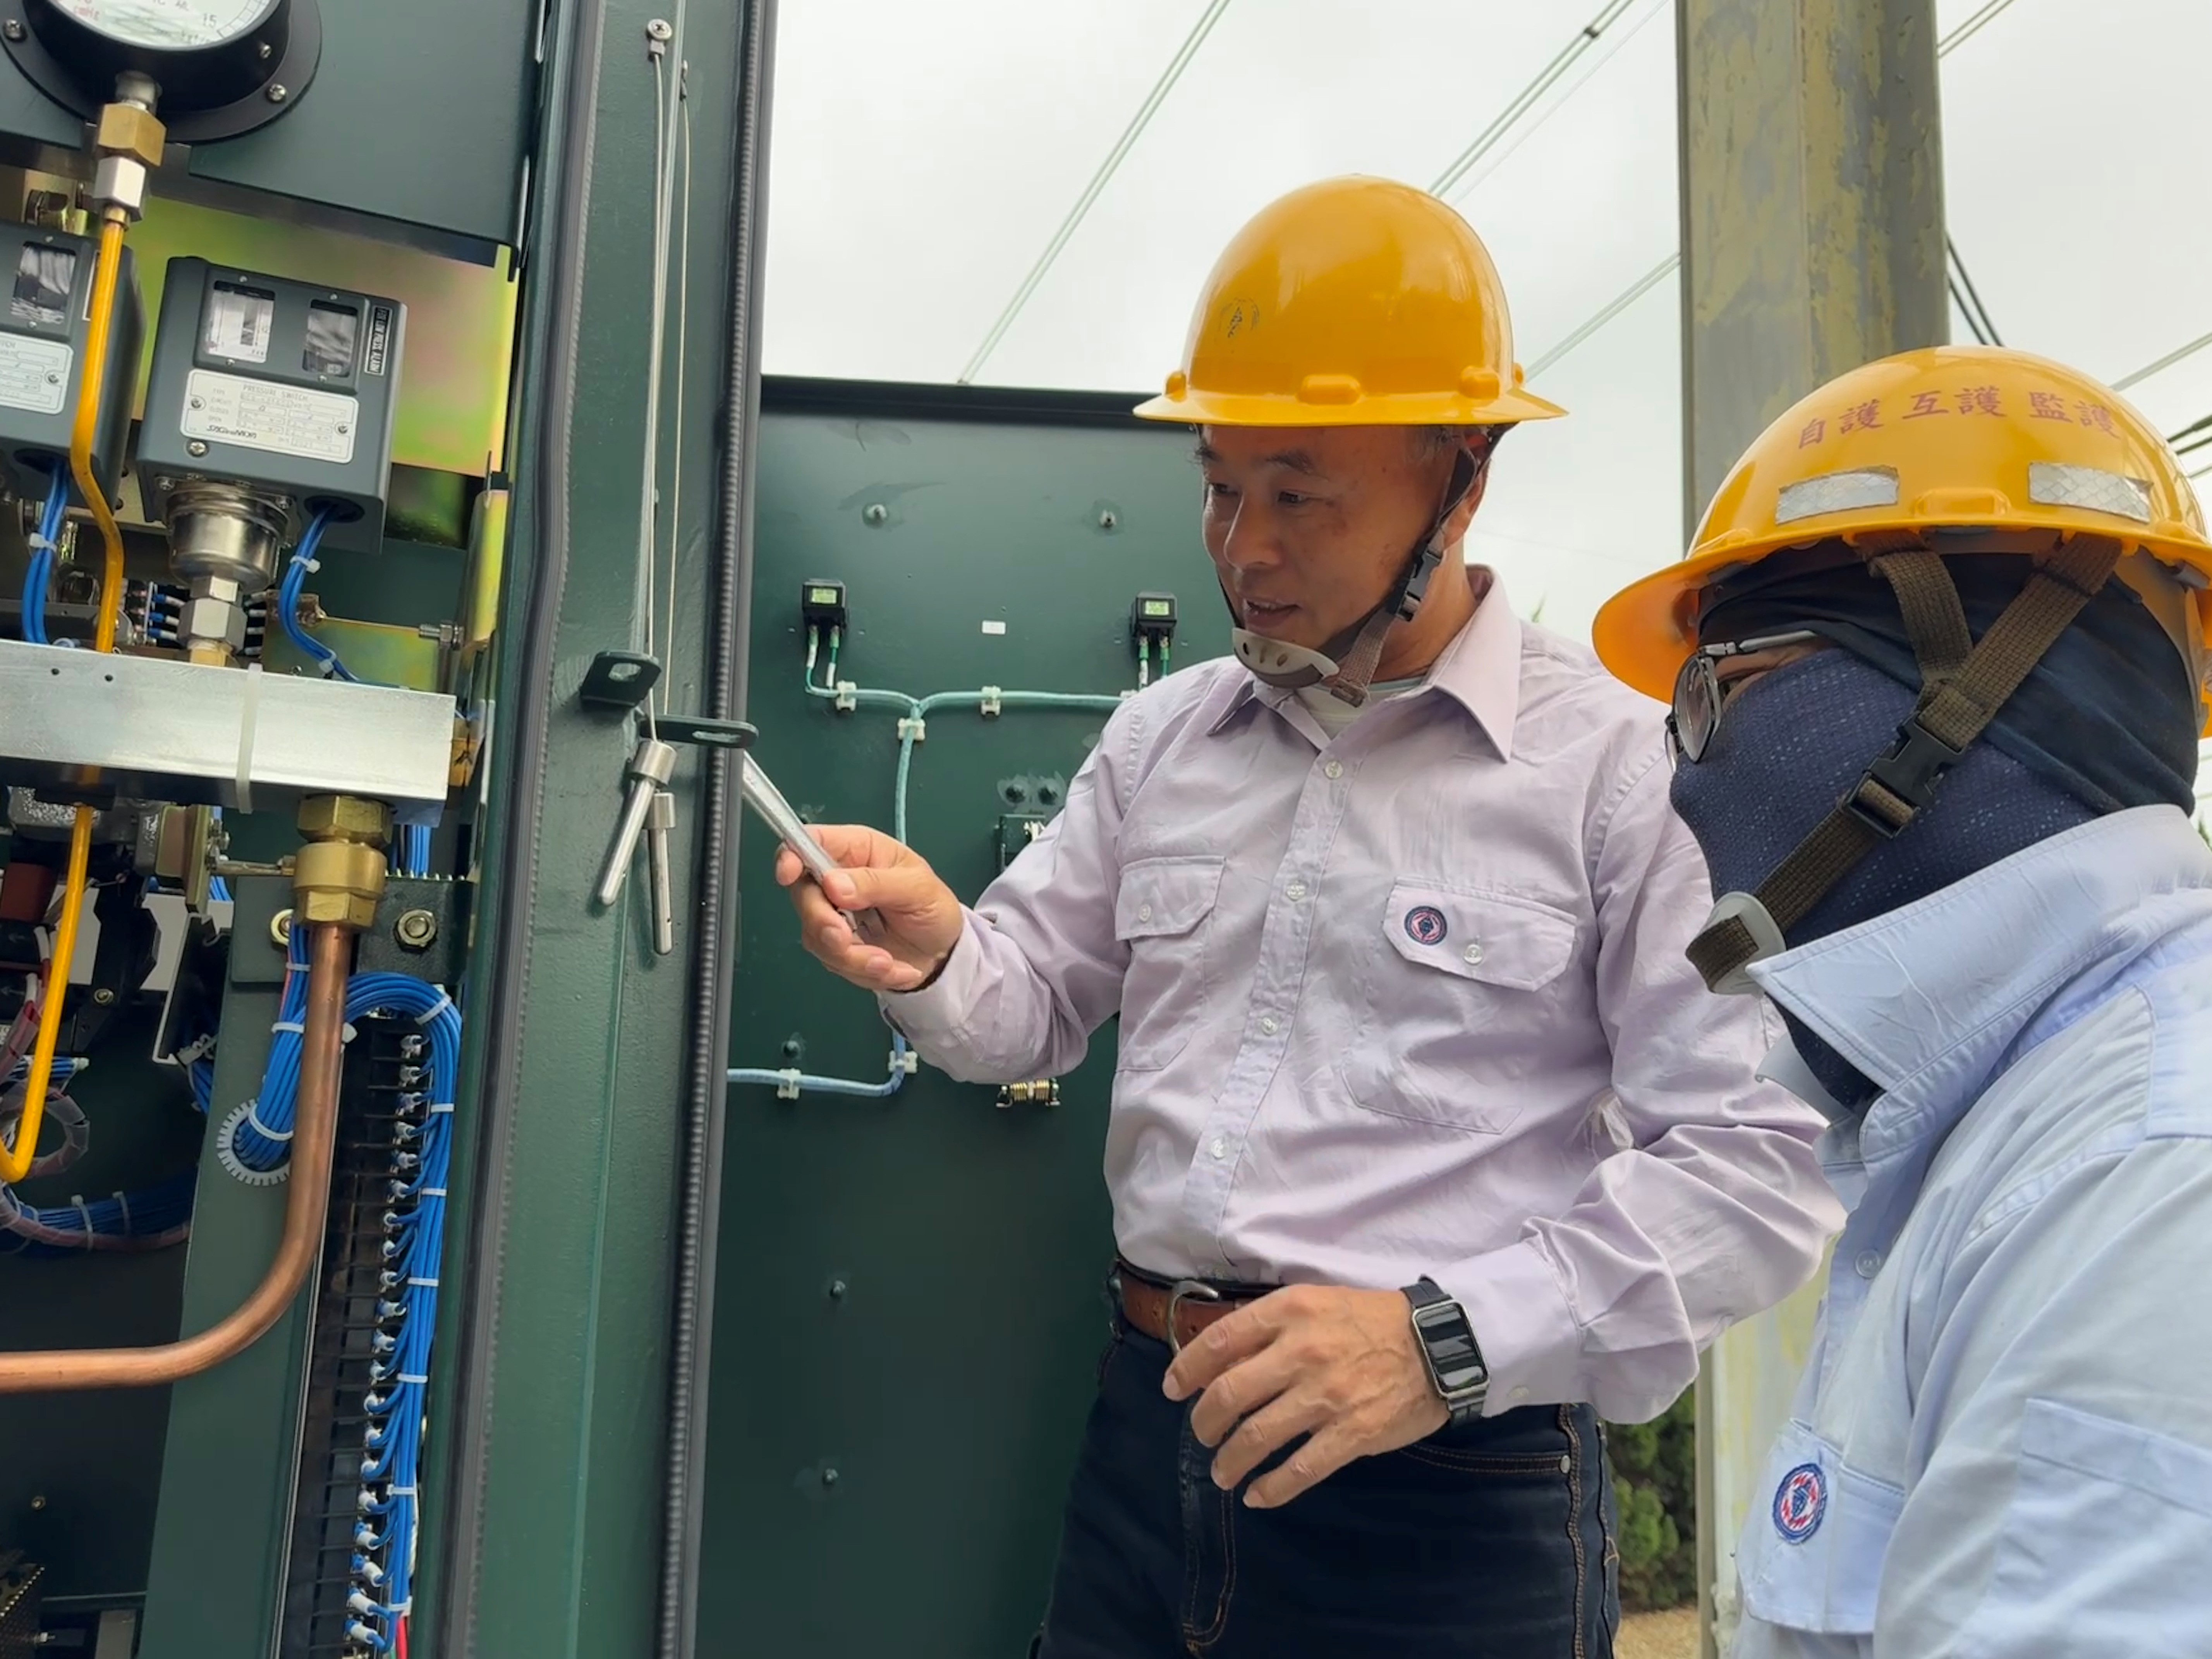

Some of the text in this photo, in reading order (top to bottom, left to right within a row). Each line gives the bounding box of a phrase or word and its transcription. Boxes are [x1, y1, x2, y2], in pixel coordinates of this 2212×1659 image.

[203, 13, 217, 27] 15
[243, 385, 276, 397] PRESSURE
[281, 390, 309, 401] SWITCH
[1798, 386, 2121, 449] 自護 互護 監護
